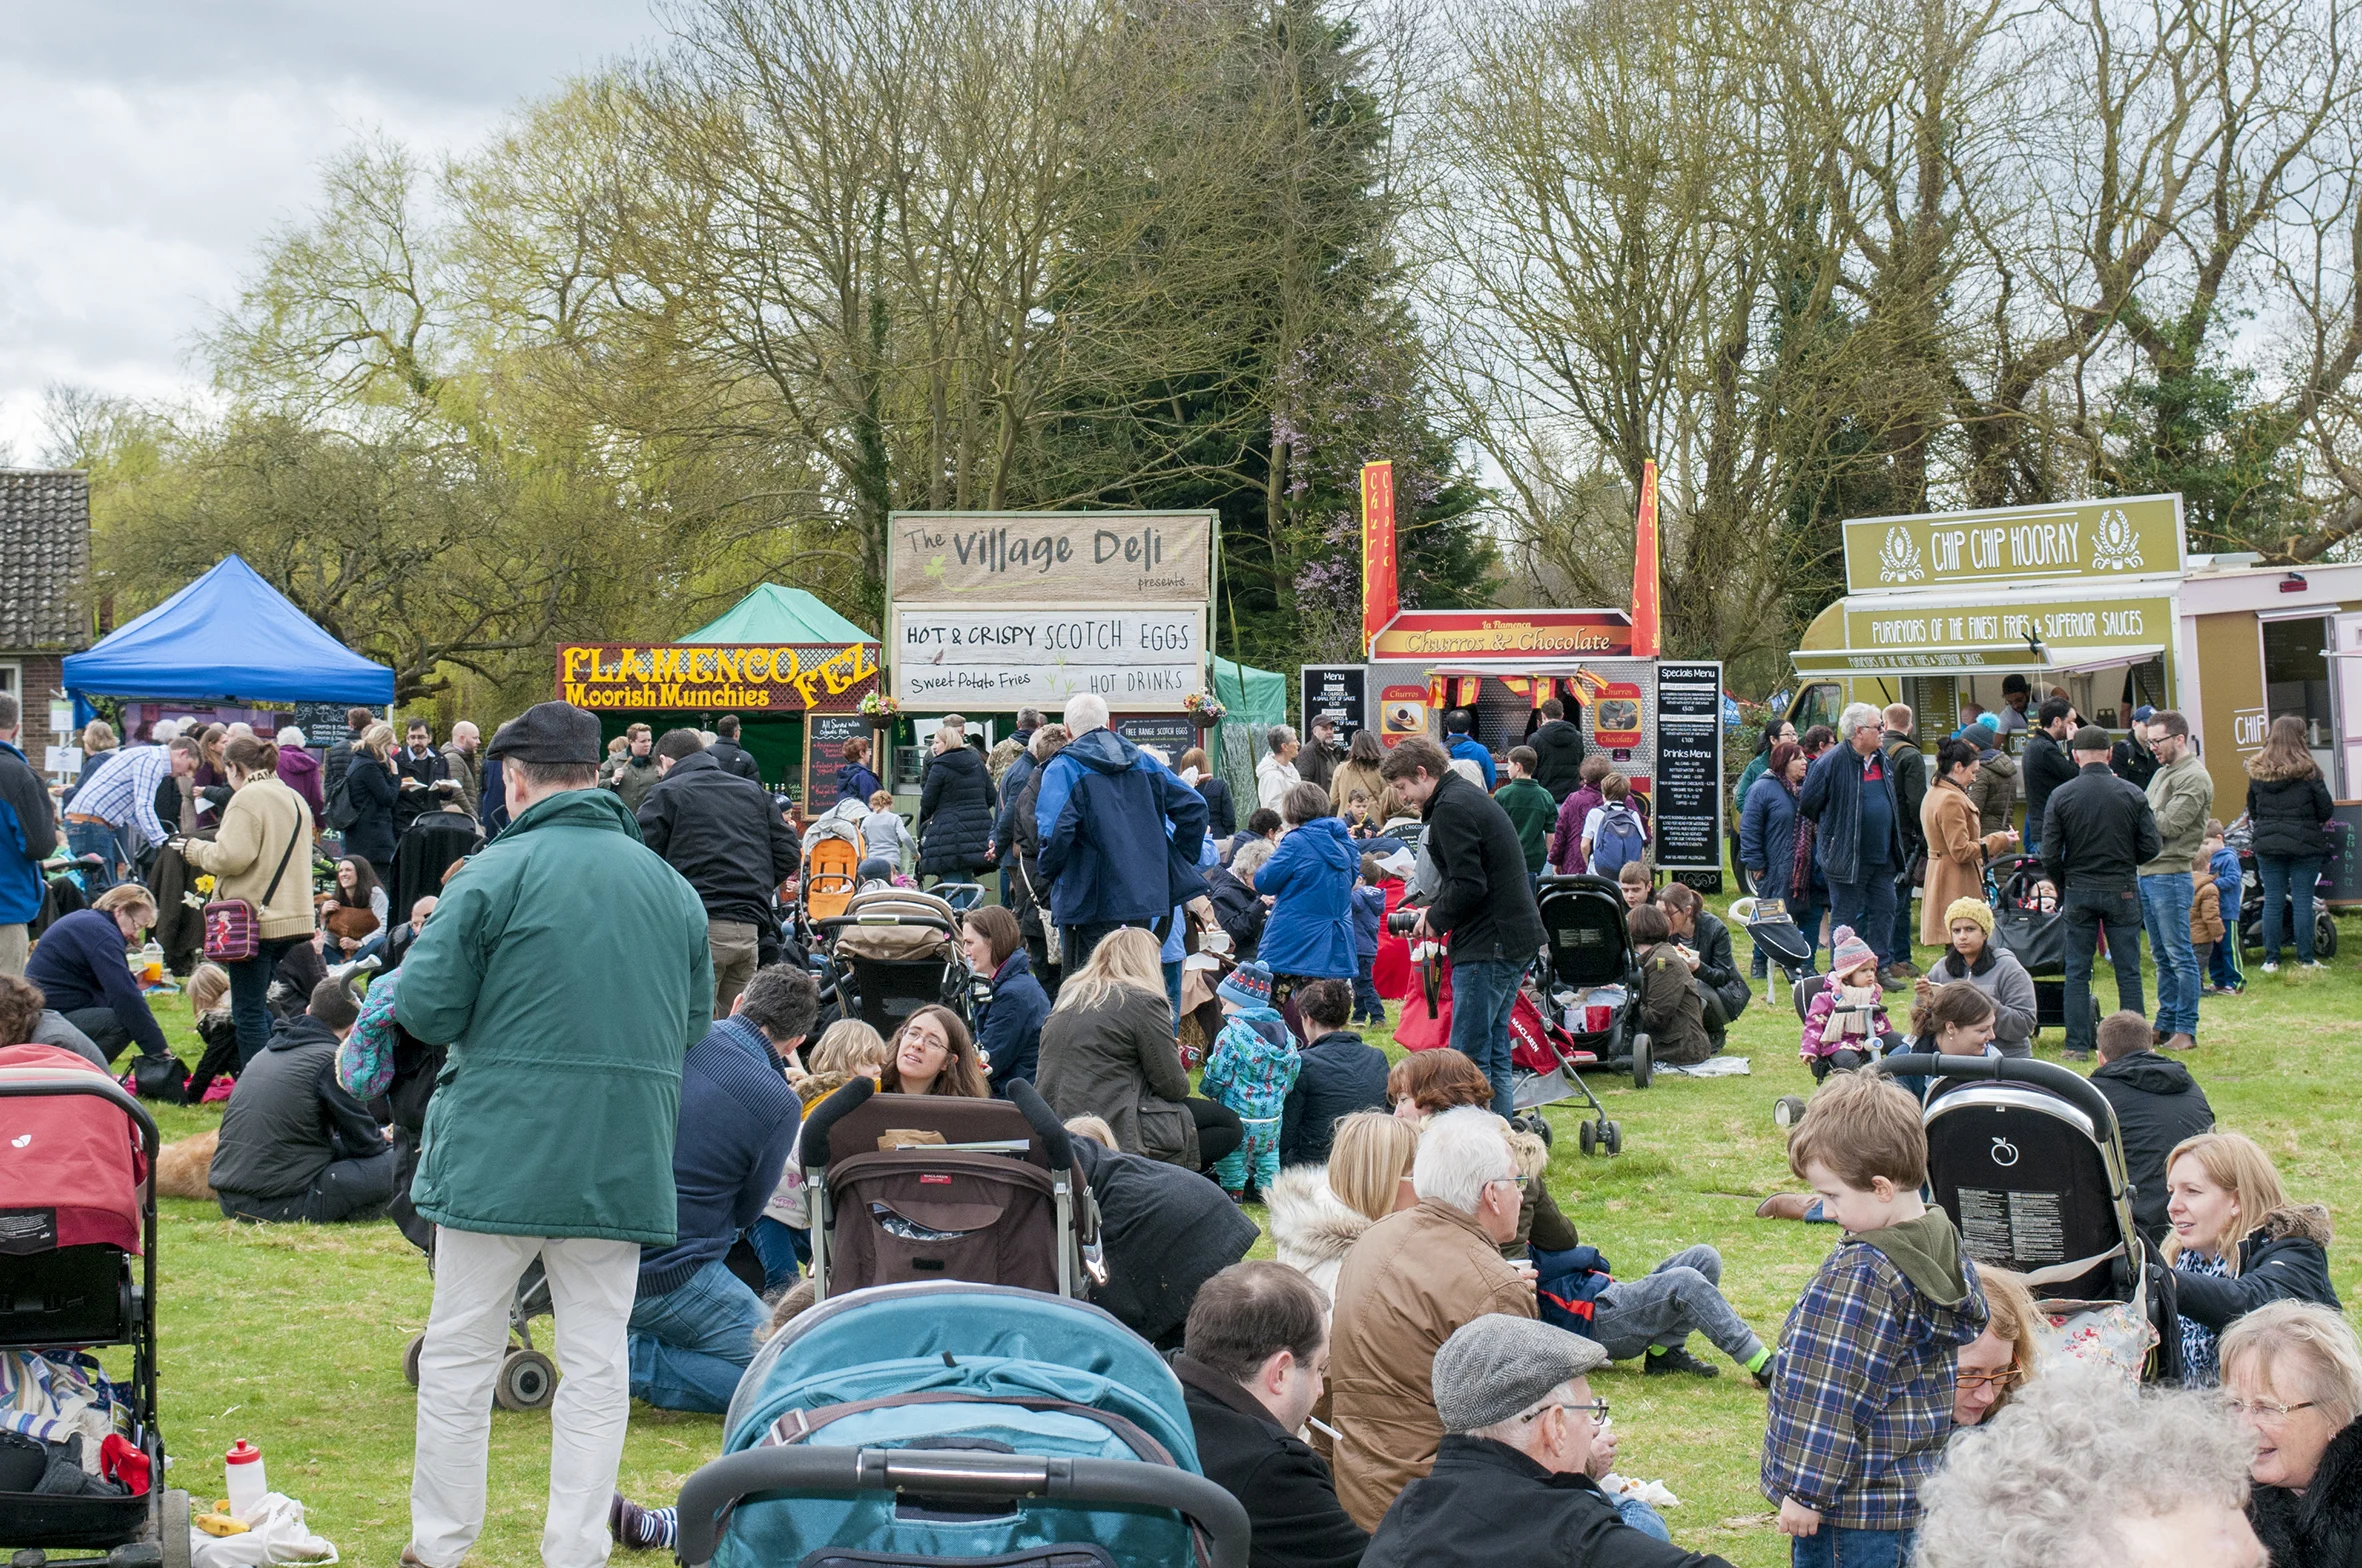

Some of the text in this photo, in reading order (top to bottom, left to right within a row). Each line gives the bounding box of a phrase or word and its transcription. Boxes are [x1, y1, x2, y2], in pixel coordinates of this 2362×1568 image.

[904, 527, 1162, 573] The Village Deli
[1931, 521, 2079, 572] CHIP CHIP HOORAY
[907, 620, 1189, 651] HOT & CRISPY SCOTCH EGGS
[1872, 610, 2143, 644] PURVEYORS OF THE FINEST FRIES & SUPERIOR SAUCES
[1405, 628, 1610, 653] Churros & Chocolate
[1848, 656, 1878, 668] PURVEYORS
[1878, 656, 1887, 667] OF
[1886, 656, 1898, 667] THE
[1897, 655, 1914, 667] FINEST
[1914, 655, 1930, 666] FRIES
[1934, 653, 1963, 666] SUPERIOR
[1962, 652, 1985, 665] SAUCES
[562, 642, 879, 710] FLAMENCO FEZ
[911, 672, 1031, 694] Sweet Potato Fries
[1090, 670, 1183, 694] HOT DRINKS
[1324, 672, 1345, 681] Menu
[1661, 668, 1716, 680] Specials Menu
[565, 683, 770, 707] Moorish Munchies
[1389, 688, 1419, 698] Churros
[1603, 687, 1633, 696] Churros
[1125, 726, 1188, 736] FREE RANGE SCOTCH EGGS
[1600, 733, 1634, 743] Chocolate
[2234, 714, 2267, 745] CHIP
[1663, 749, 1712, 759] Drinks Menu
[1511, 1017, 1540, 1053] MACLAREN
